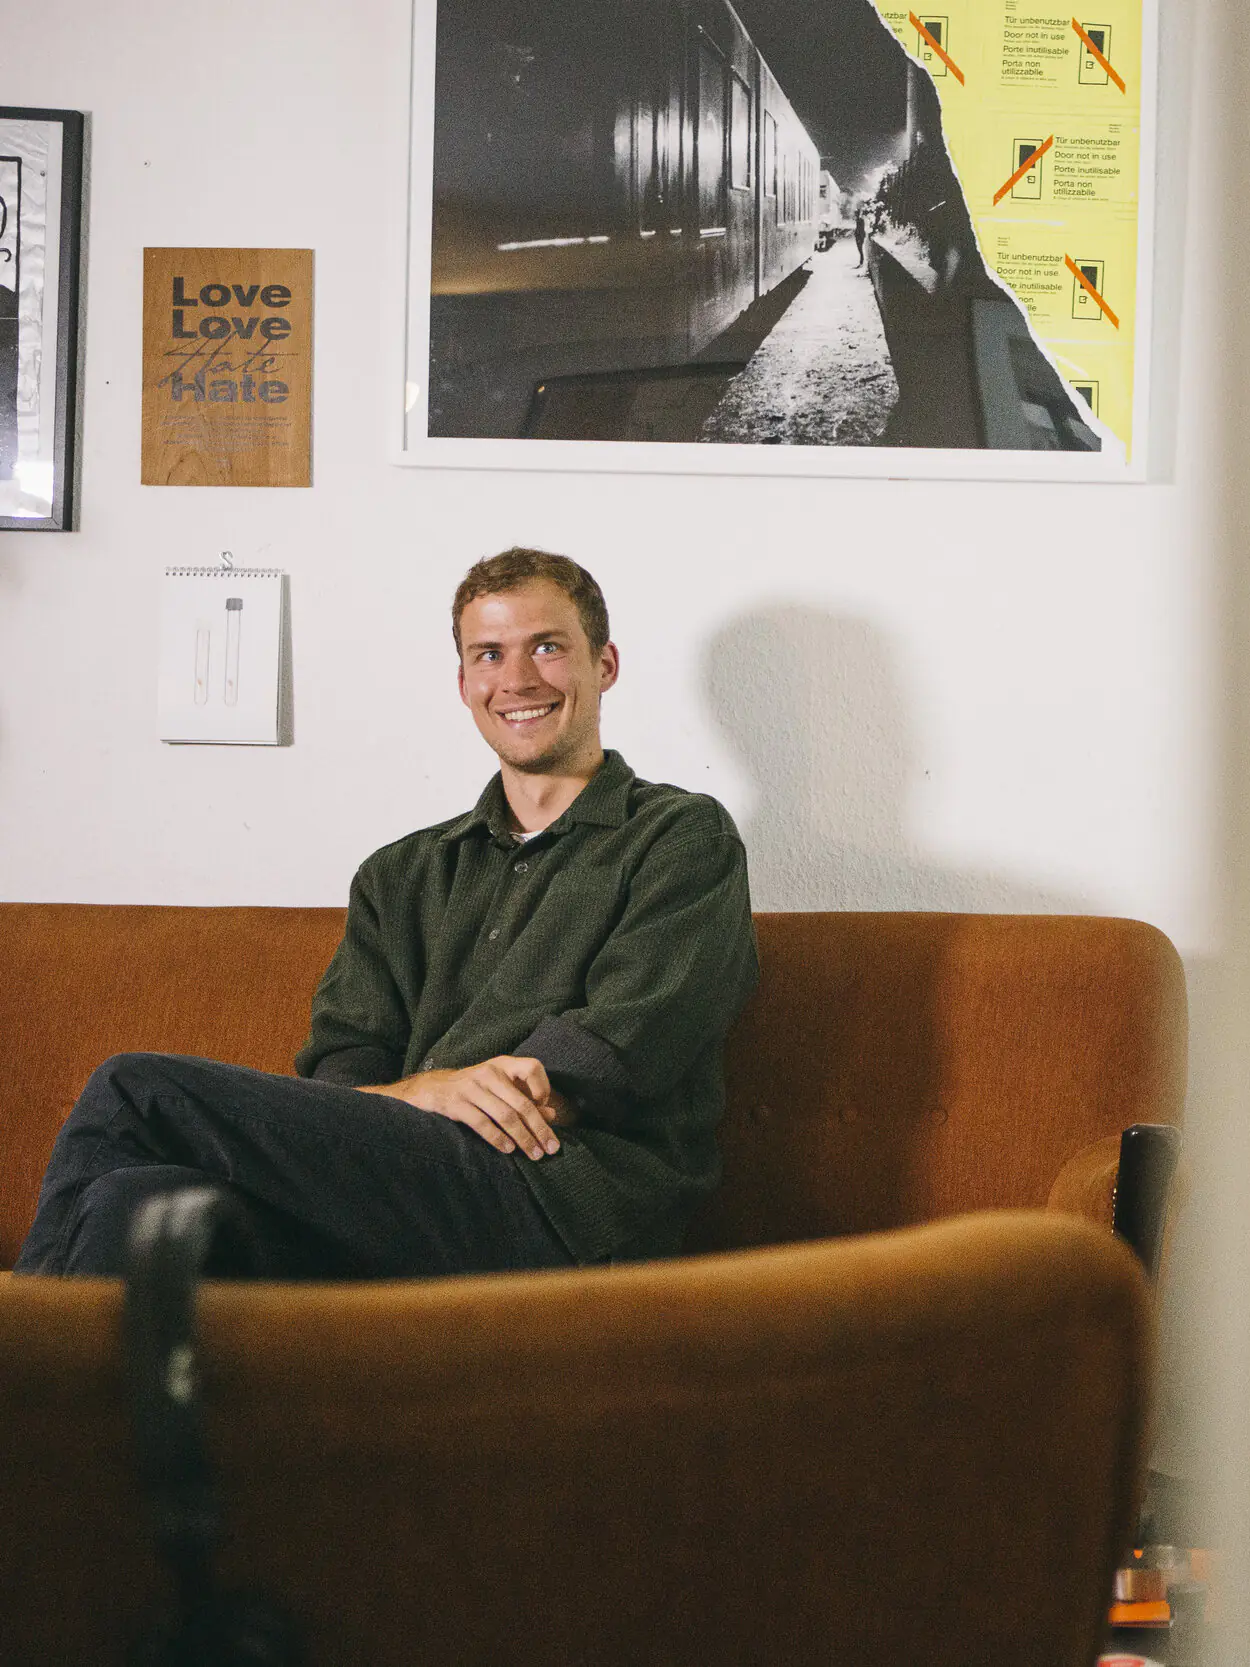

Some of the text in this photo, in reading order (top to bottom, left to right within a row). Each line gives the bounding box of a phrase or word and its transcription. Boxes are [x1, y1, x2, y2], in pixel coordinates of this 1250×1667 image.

[1005, 15, 1070, 26] Tür unbenutzbar
[1004, 30, 1024, 39] Door
[1025, 32, 1039, 40] not
[1003, 45, 1069, 55] Porte inutilisable
[1002, 60, 1023, 68] Porta
[1001, 68, 1044, 77] utilizzabile
[1055, 136, 1121, 146] Tür unbenutzbar
[1054, 151, 1074, 159] Door
[1054, 165, 1120, 175] Porte inutilisable
[1053, 179, 1074, 187] Porta
[1053, 188, 1096, 196] utilizzabile
[1011, 254, 1063, 262] unbenutzbar
[996, 266, 1017, 275] Door
[1018, 268, 1032, 276] not
[1034, 268, 1042, 276] in
[1019, 282, 1063, 291] inutilisable
[172, 276, 292, 308] Love
[172, 309, 292, 340] Love
[171, 372, 290, 403] Hate
